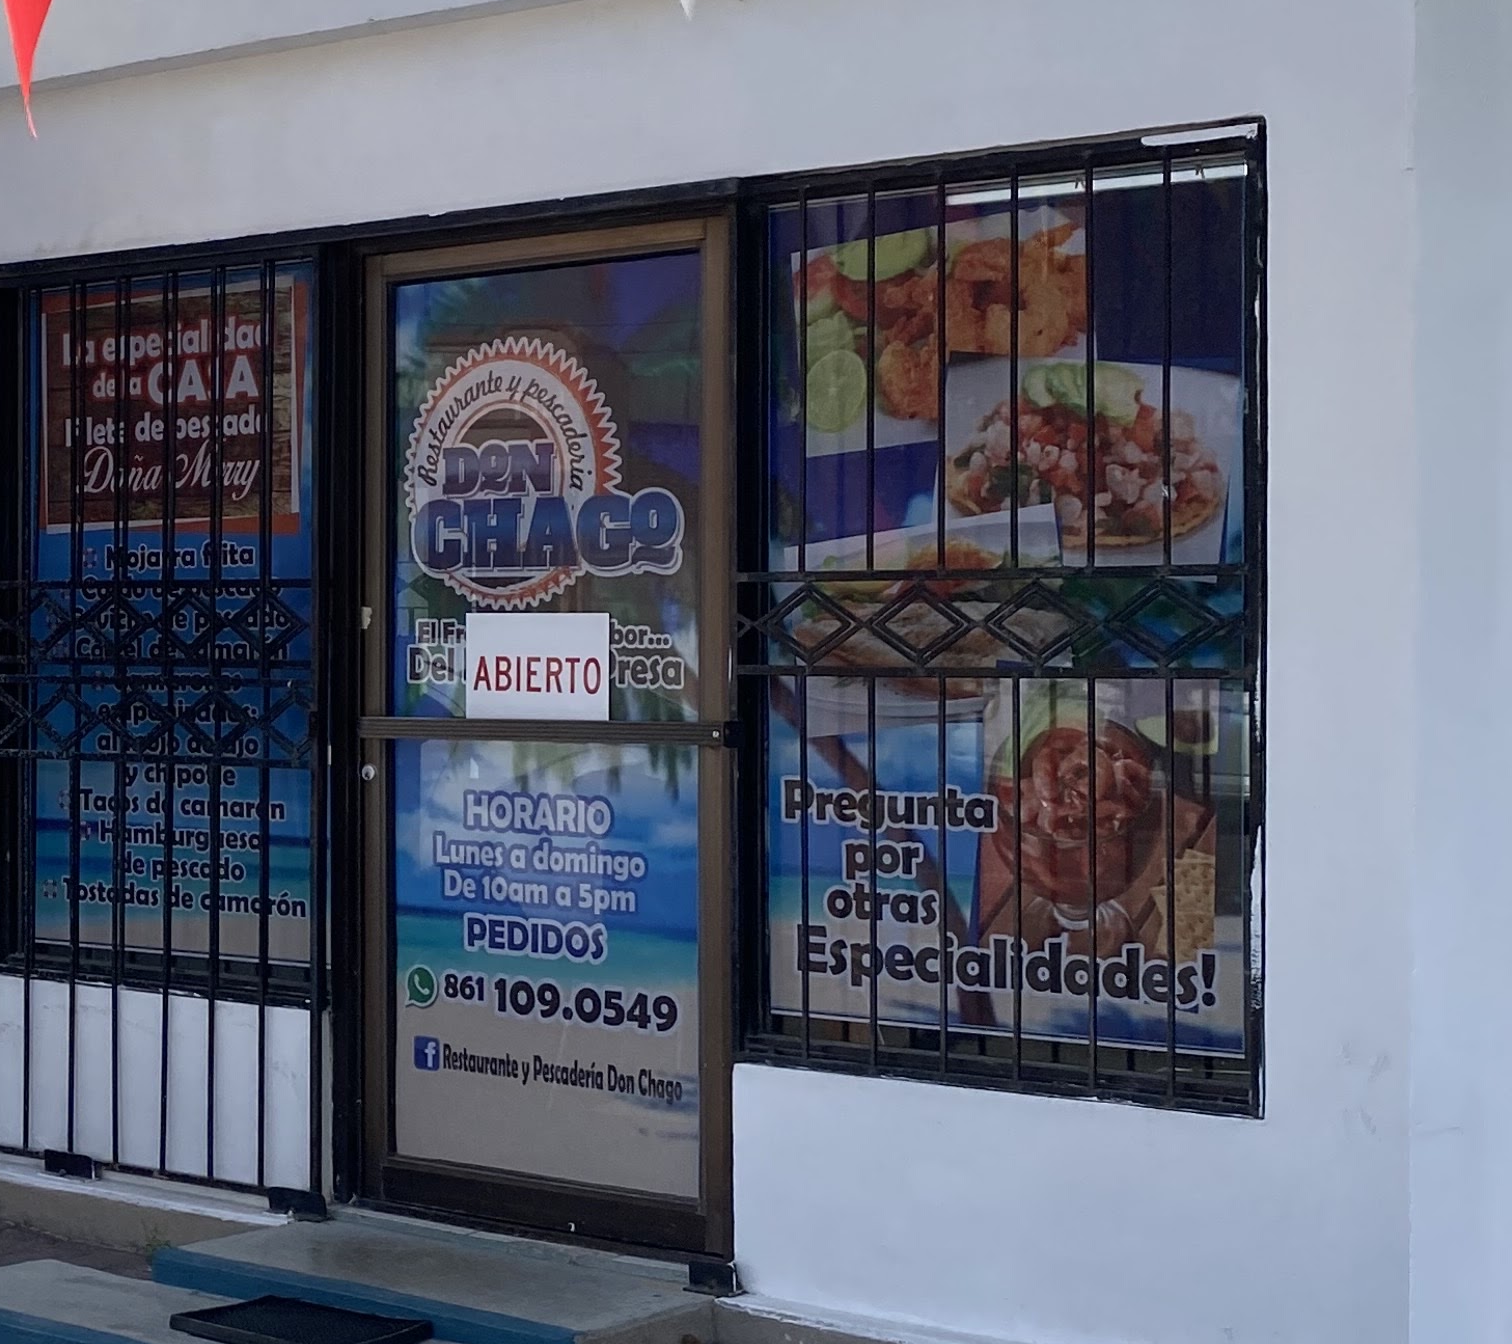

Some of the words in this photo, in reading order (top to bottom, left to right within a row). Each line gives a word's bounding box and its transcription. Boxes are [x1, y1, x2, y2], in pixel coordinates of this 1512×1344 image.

[135, 411, 165, 443] de
[417, 370, 504, 487] Restaurante
[506, 375, 522, 400] y
[170, 438, 261, 501] Mrry
[442, 443, 555, 496] DON
[414, 493, 678, 571] CHAGO
[106, 544, 196, 572] Mojara
[202, 541, 255, 566] fita
[81, 576, 147, 600] Cado
[417, 621, 437, 645] El
[610, 620, 671, 647] bor...
[409, 647, 456, 682] Del
[473, 656, 602, 695] ABIERTO
[145, 762, 236, 789] chpoe
[466, 793, 612, 835] HORARIO
[784, 778, 996, 830] Pregunta
[152, 856, 245, 881] pescado
[436, 835, 505, 869] Lunes
[510, 848, 526, 869] a
[533, 842, 646, 881] domingo
[845, 842, 921, 878] por
[170, 885, 194, 910] de
[444, 870, 477, 899] De
[483, 875, 548, 905] 10am
[555, 886, 572, 907] a
[579, 883, 636, 915] 5pm
[826, 883, 939, 924] otras
[467, 917, 605, 960] PEDIDOS
[796, 924, 1217, 1008] Especialidades!
[444, 973, 485, 1002] 861
[494, 978, 679, 1032] 109.0549
[443, 1043, 520, 1079] Restaurante
[521, 1064, 531, 1086] y
[534, 1054, 604, 1091] Pescadería
[608, 1064, 636, 1095] Don
[639, 1068, 683, 1105] Chago
